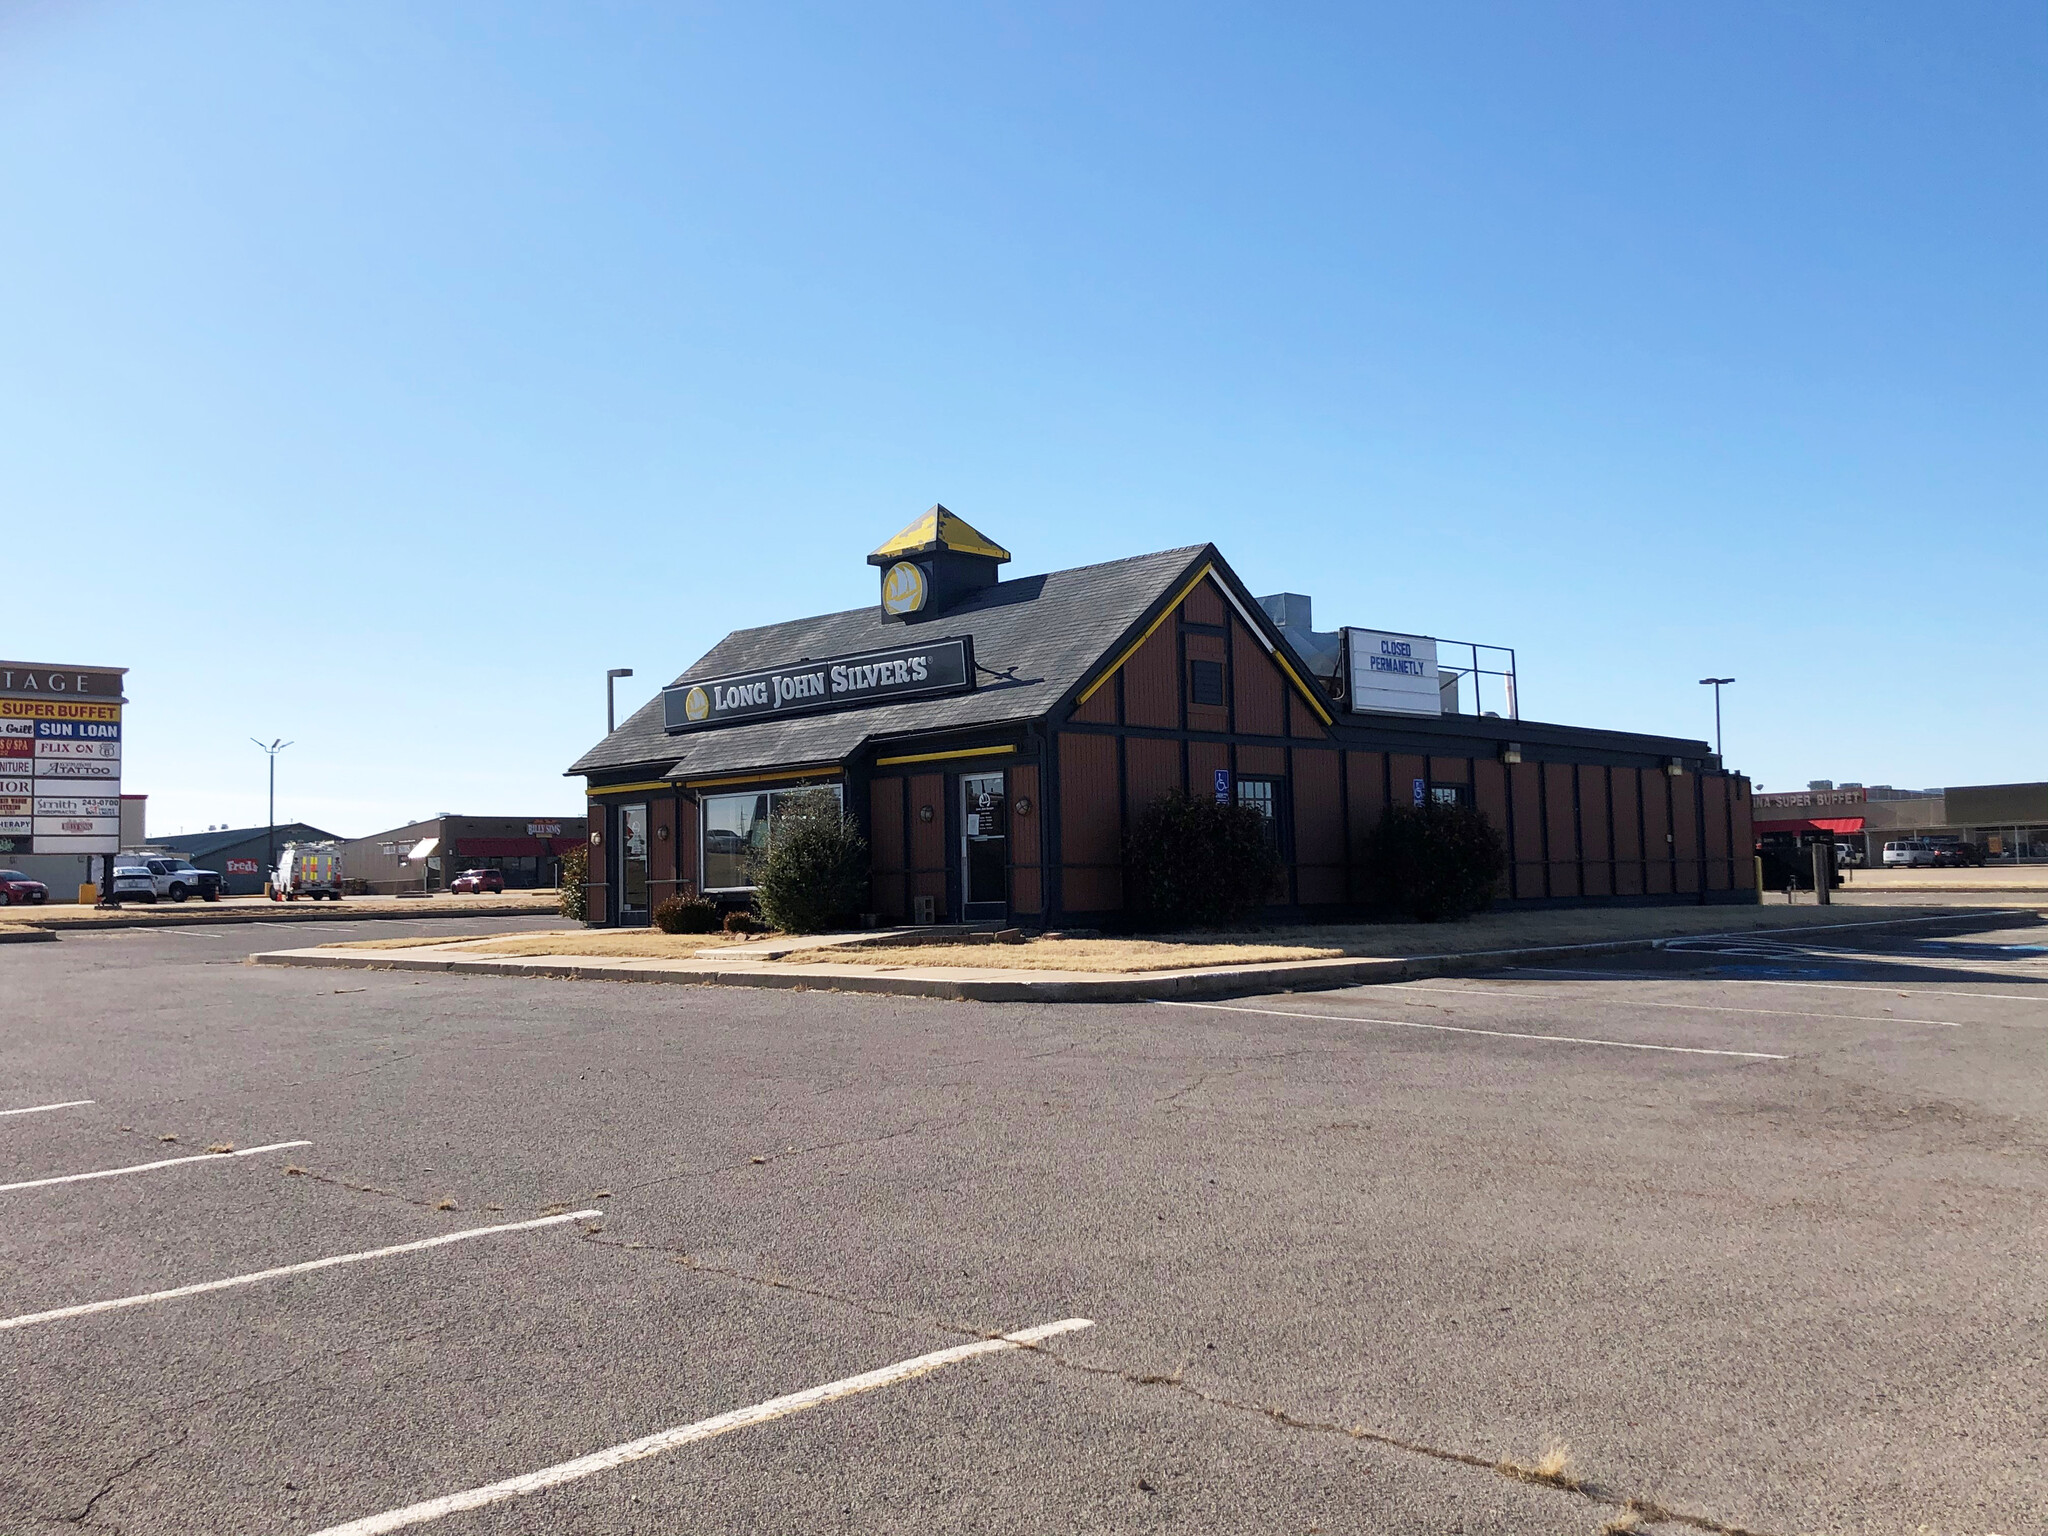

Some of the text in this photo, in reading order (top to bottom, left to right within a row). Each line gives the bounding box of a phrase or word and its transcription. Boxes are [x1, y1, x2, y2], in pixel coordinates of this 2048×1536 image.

[1381, 640, 1411, 657] CLOSED
[1370, 655, 1424, 676] PERMANETLY
[714, 656, 927, 711] LONG JOHN SILVER'S
[2, 702, 116, 719] SUPER BUFFET
[40, 722, 118, 738] SUN LOAN
[40, 743, 70, 753] FLIX
[75, 744, 94, 754] ON
[37, 799, 77, 810] Smith
[1775, 794, 1811, 808] SUPER
[1816, 791, 1860, 806] BUFFET
[226, 860, 259, 873] Fred's
